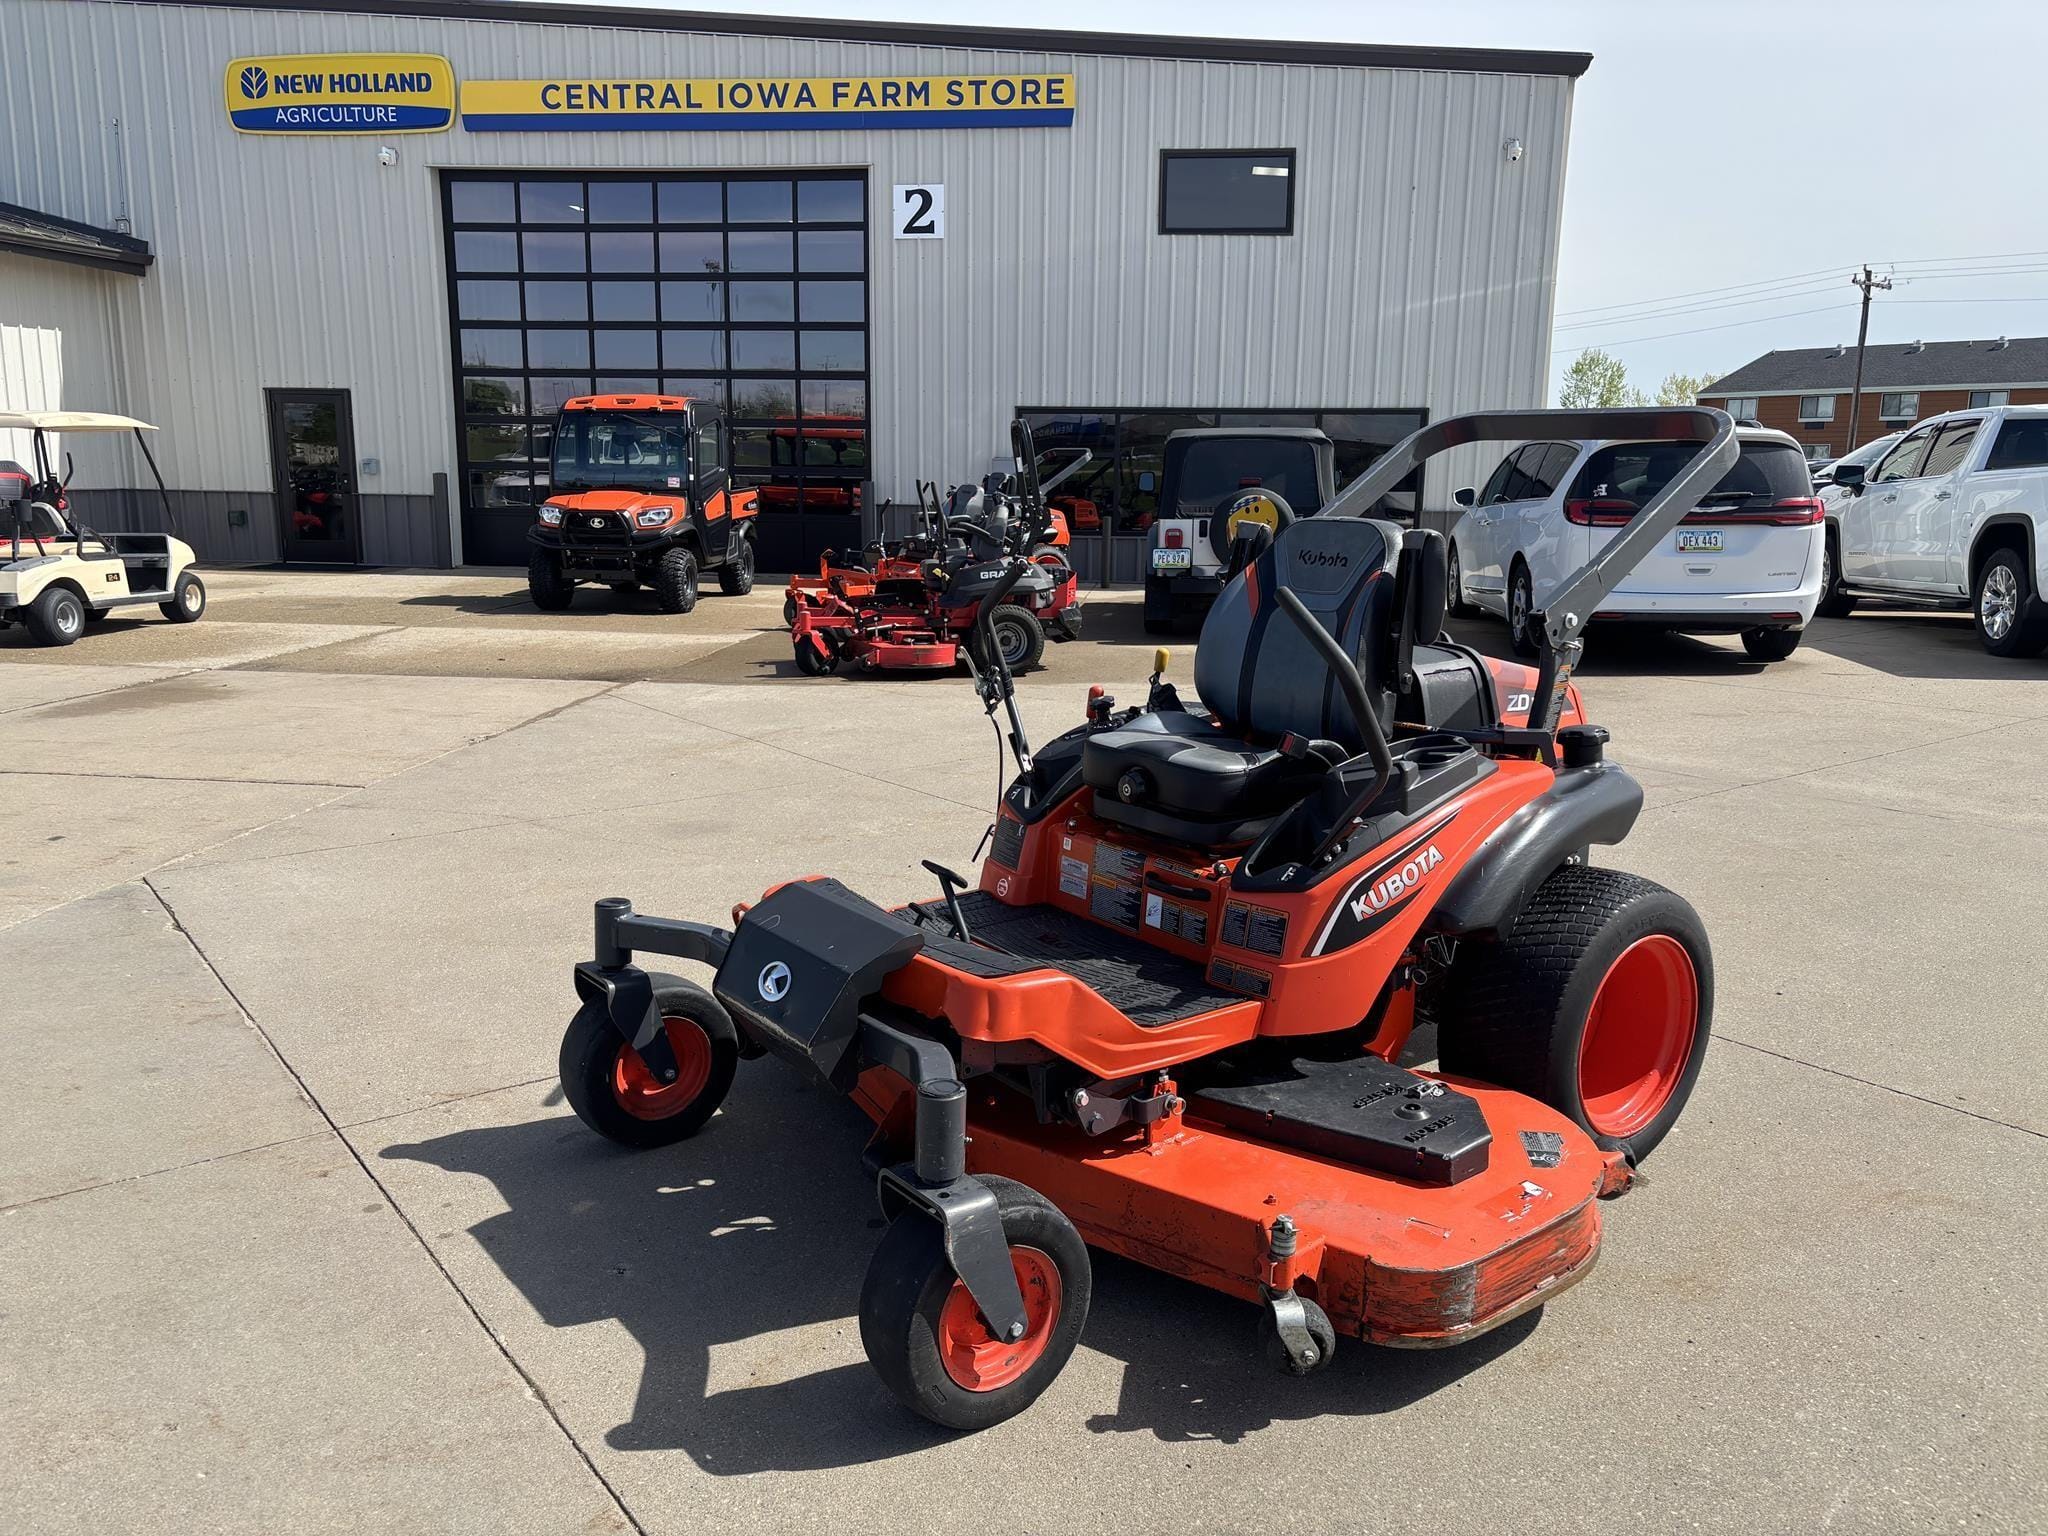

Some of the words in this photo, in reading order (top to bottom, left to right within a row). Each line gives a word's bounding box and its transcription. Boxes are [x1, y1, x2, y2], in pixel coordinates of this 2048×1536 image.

[274, 75, 323, 94] NEW
[329, 73, 432, 93] HOLLAND
[541, 83, 703, 110] CENTRAL
[718, 82, 817, 109] IOWA
[832, 81, 930, 108] FARM
[946, 78, 1065, 106] STORE
[276, 107, 397, 123] AGRICULTURE
[903, 189, 935, 234] 2
[1702, 535, 1718, 547] 443
[1299, 549, 1349, 568] Kubota
[1350, 845, 1445, 922] KUBOTA
